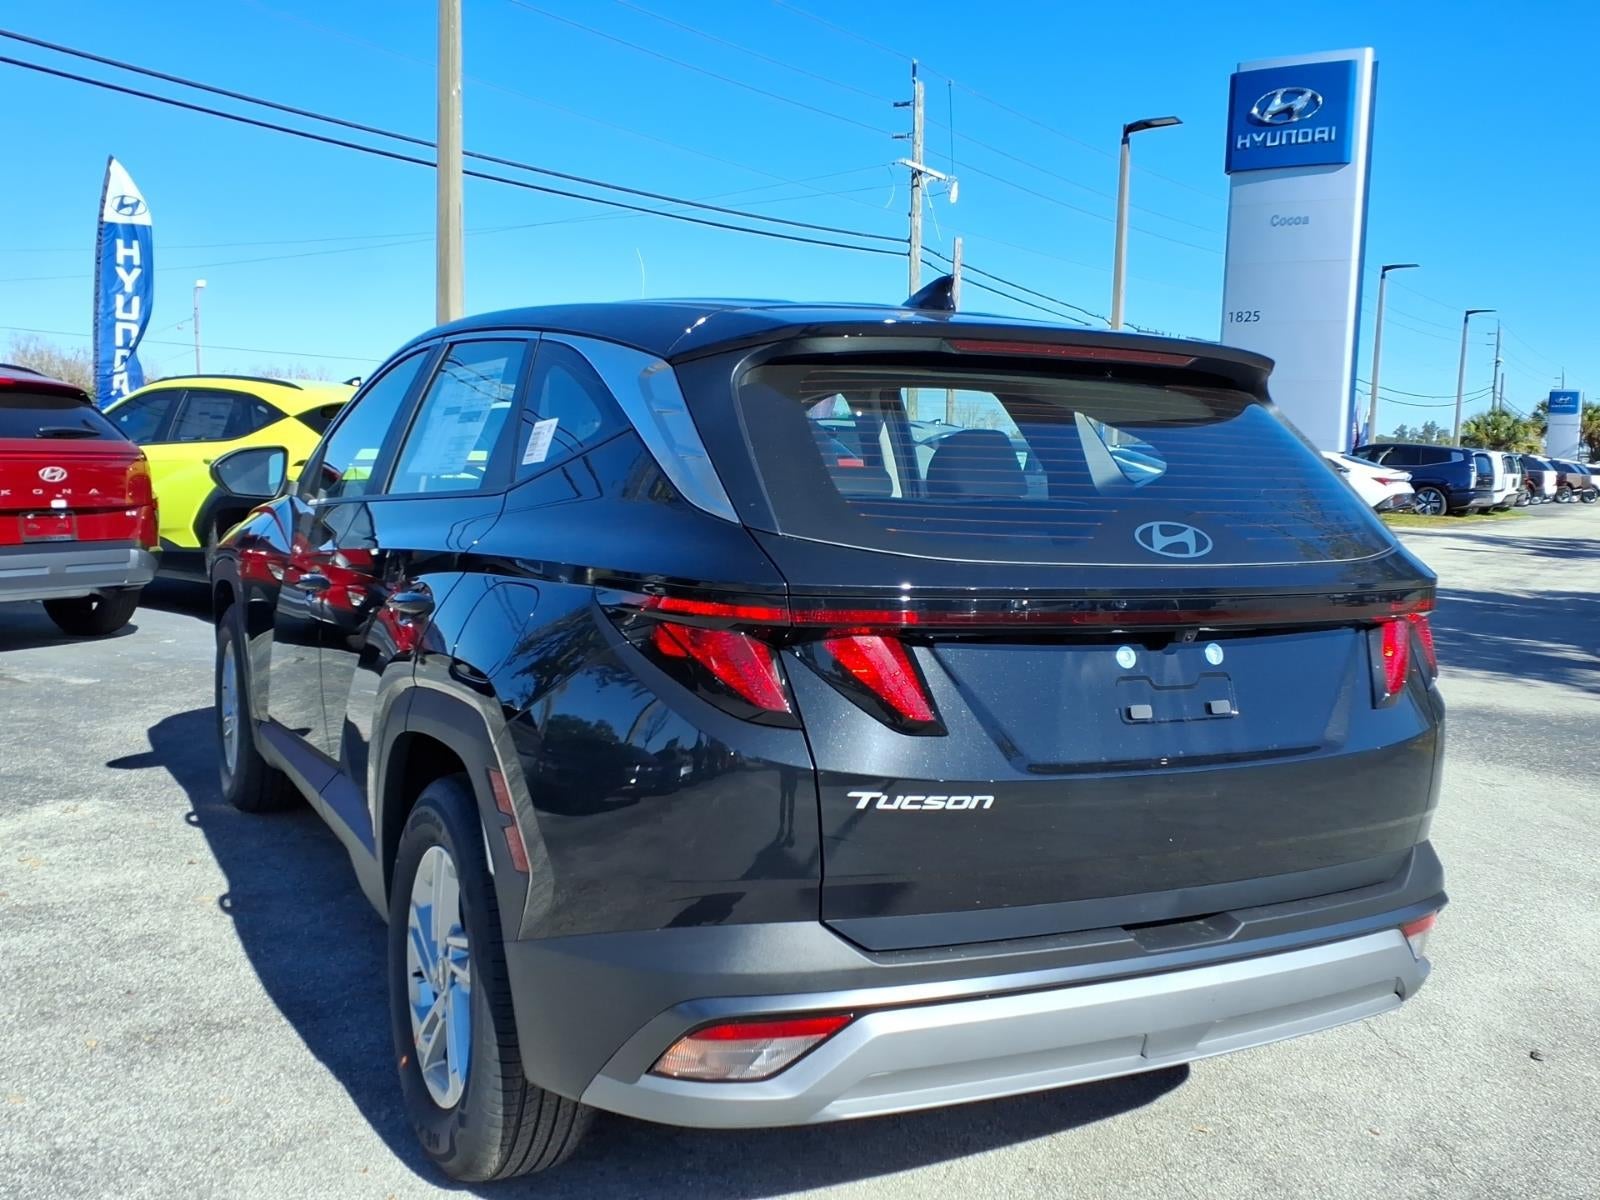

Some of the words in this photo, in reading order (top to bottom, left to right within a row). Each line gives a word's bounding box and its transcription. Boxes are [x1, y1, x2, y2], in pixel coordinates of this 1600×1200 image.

[1236, 126, 1337, 149] HYUNDAI
[1270, 214, 1310, 227] Cocoa
[1228, 310, 1261, 323] 1825
